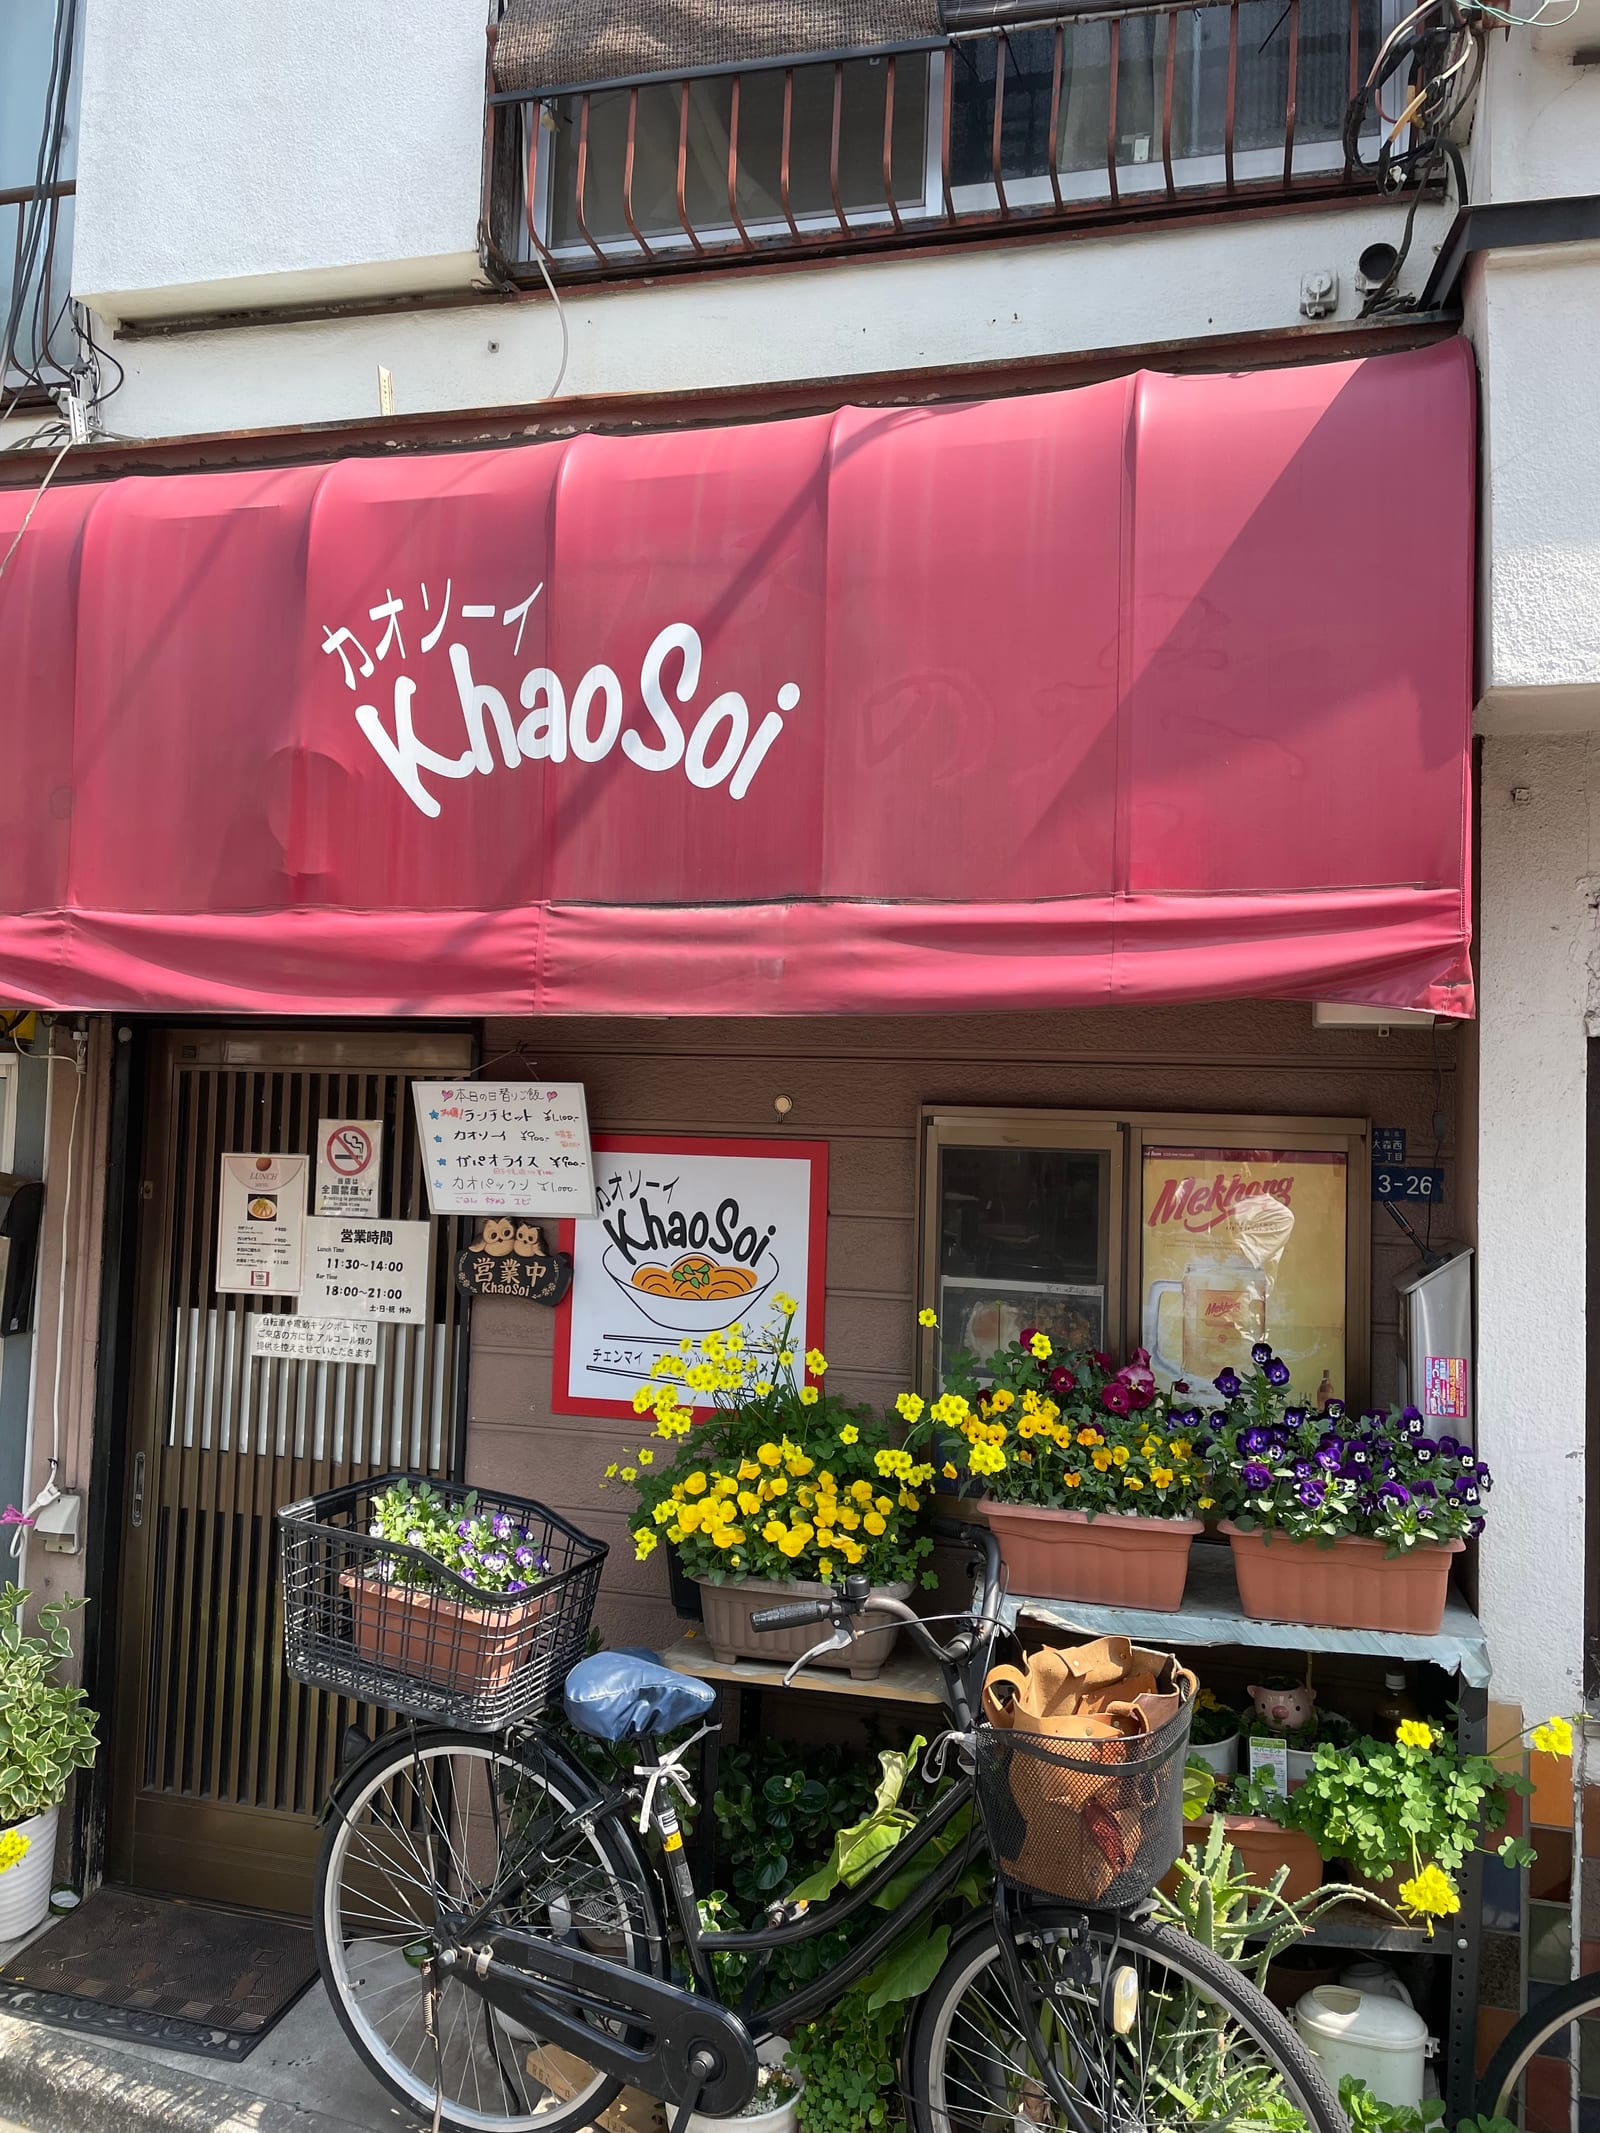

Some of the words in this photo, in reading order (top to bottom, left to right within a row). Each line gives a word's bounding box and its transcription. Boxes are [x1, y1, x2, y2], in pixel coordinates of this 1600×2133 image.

[321, 577, 544, 691] カオソーイ
[453, 1129, 508, 1142] カオソーイ
[1372, 1139, 1403, 1151] 大森西
[1377, 1174, 1433, 1195] 3-26
[1147, 1173, 1296, 1234] Mekhong
[340, 1228, 393, 1246] 営業時間
[472, 1257, 548, 1288] 営業中
[481, 1281, 531, 1298] KhaoSoi
